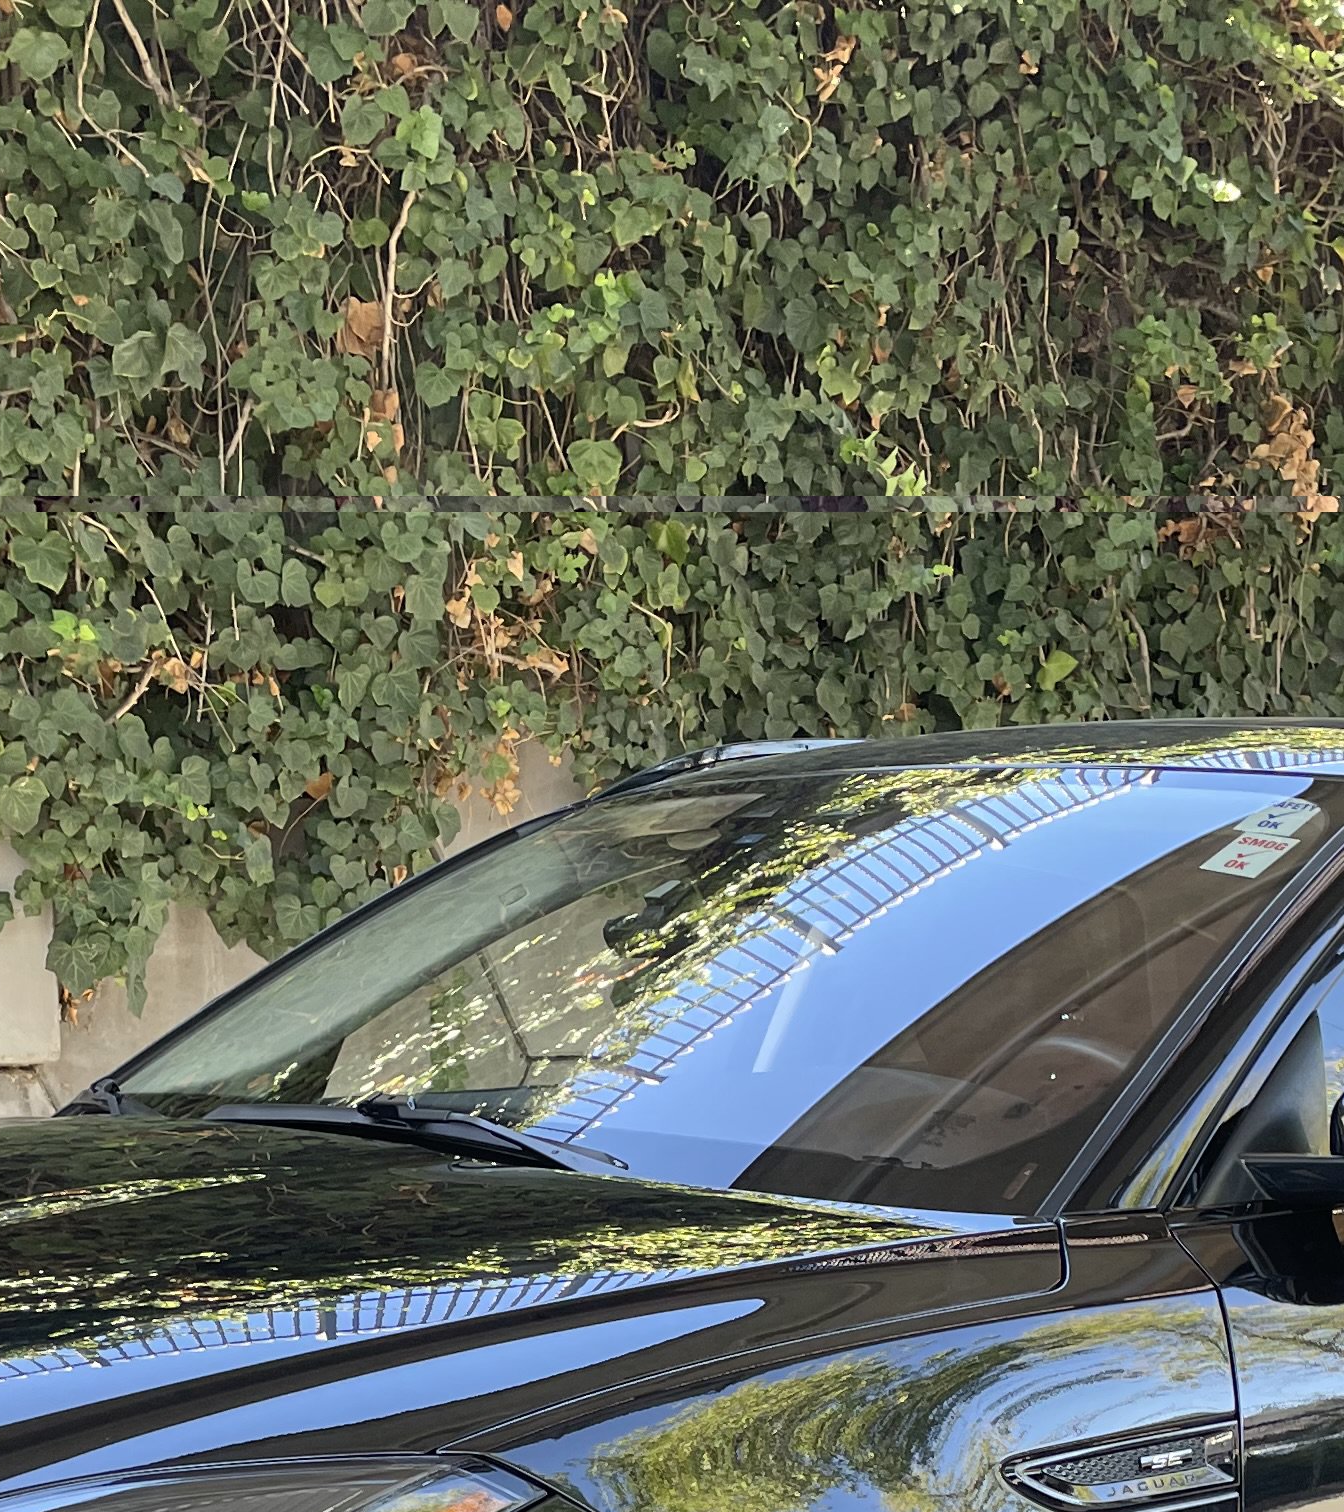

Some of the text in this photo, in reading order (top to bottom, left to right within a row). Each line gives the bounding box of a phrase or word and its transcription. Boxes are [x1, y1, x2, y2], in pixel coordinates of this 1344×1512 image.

[1257, 819, 1281, 830] OK
[1237, 836, 1288, 851] SMOG
[1224, 859, 1250, 870] OK
[1107, 1473, 1195, 1498] JAGUAR
